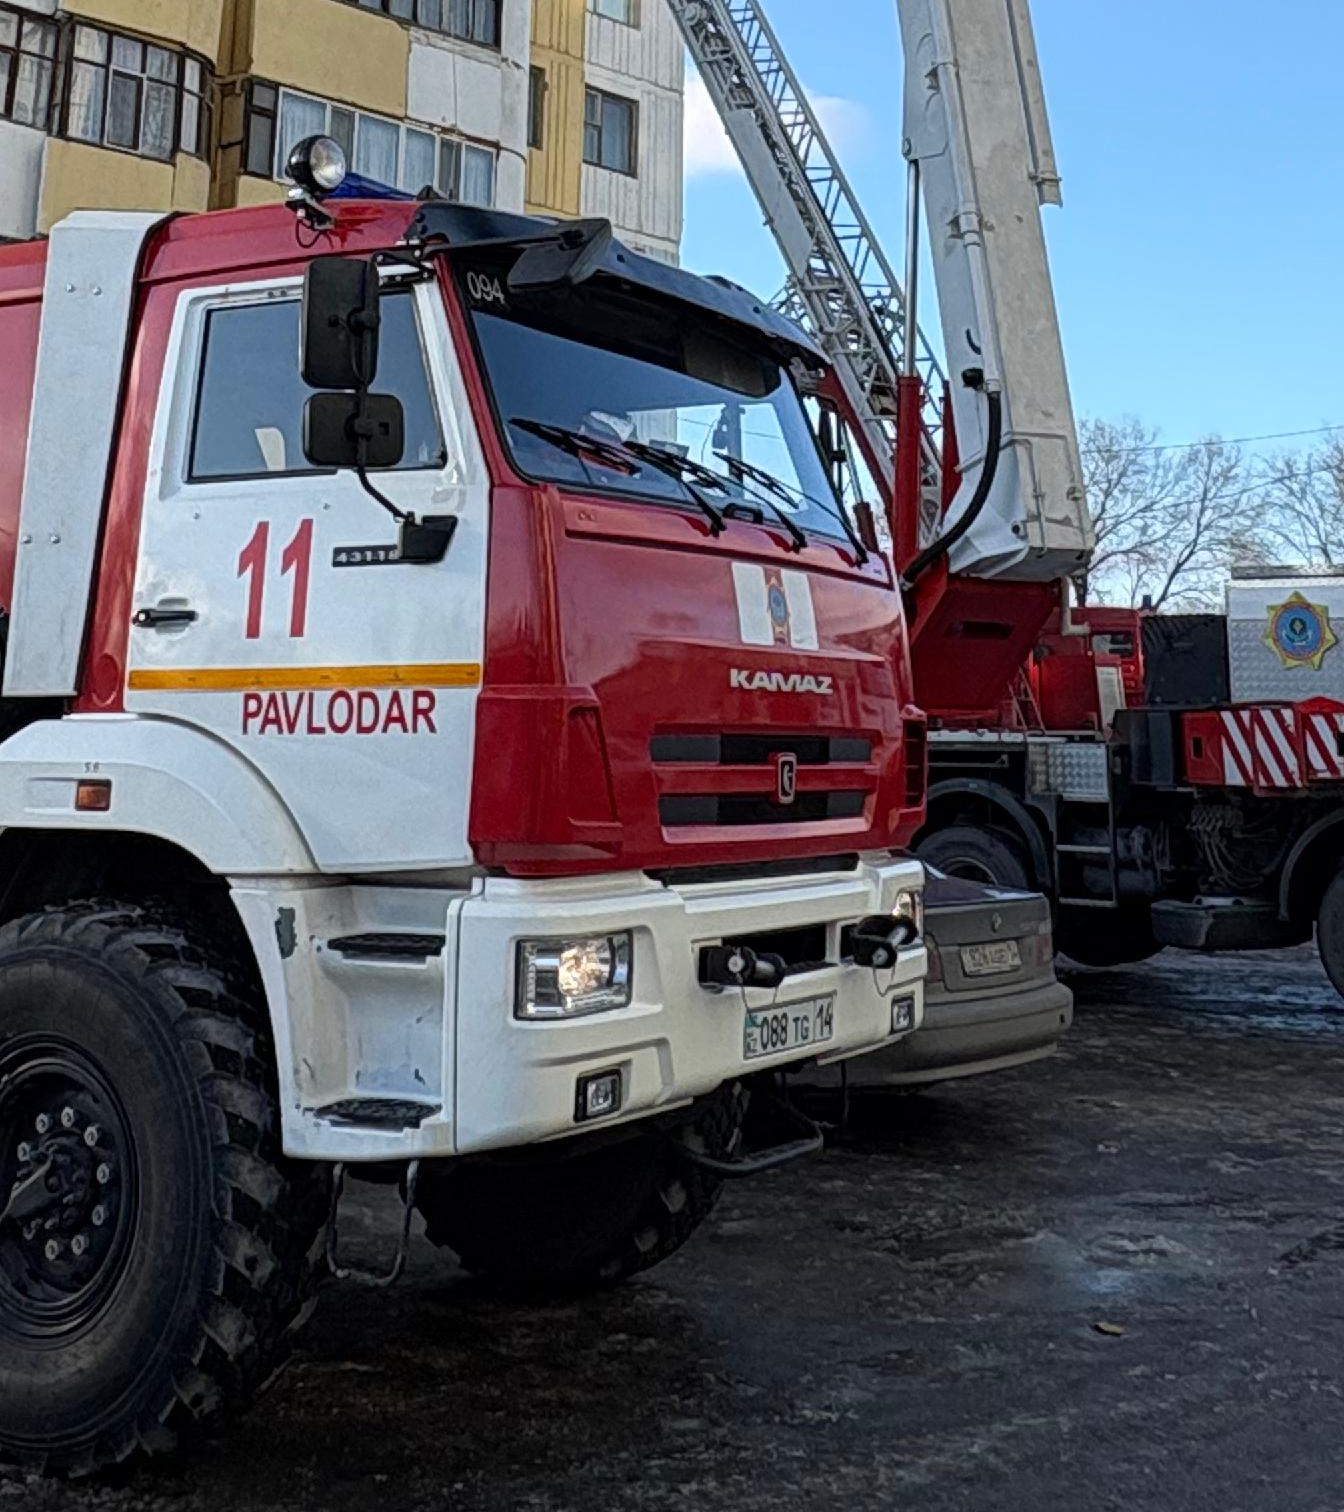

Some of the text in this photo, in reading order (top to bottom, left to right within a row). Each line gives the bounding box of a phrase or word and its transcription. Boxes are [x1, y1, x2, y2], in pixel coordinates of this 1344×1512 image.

[467, 271, 505, 304] 094
[237, 519, 314, 639] 11
[730, 668, 834, 695] KAMAZ
[242, 690, 438, 735] PAVLODAR
[760, 1011, 789, 1051] 088
[792, 1014, 810, 1042] TG
